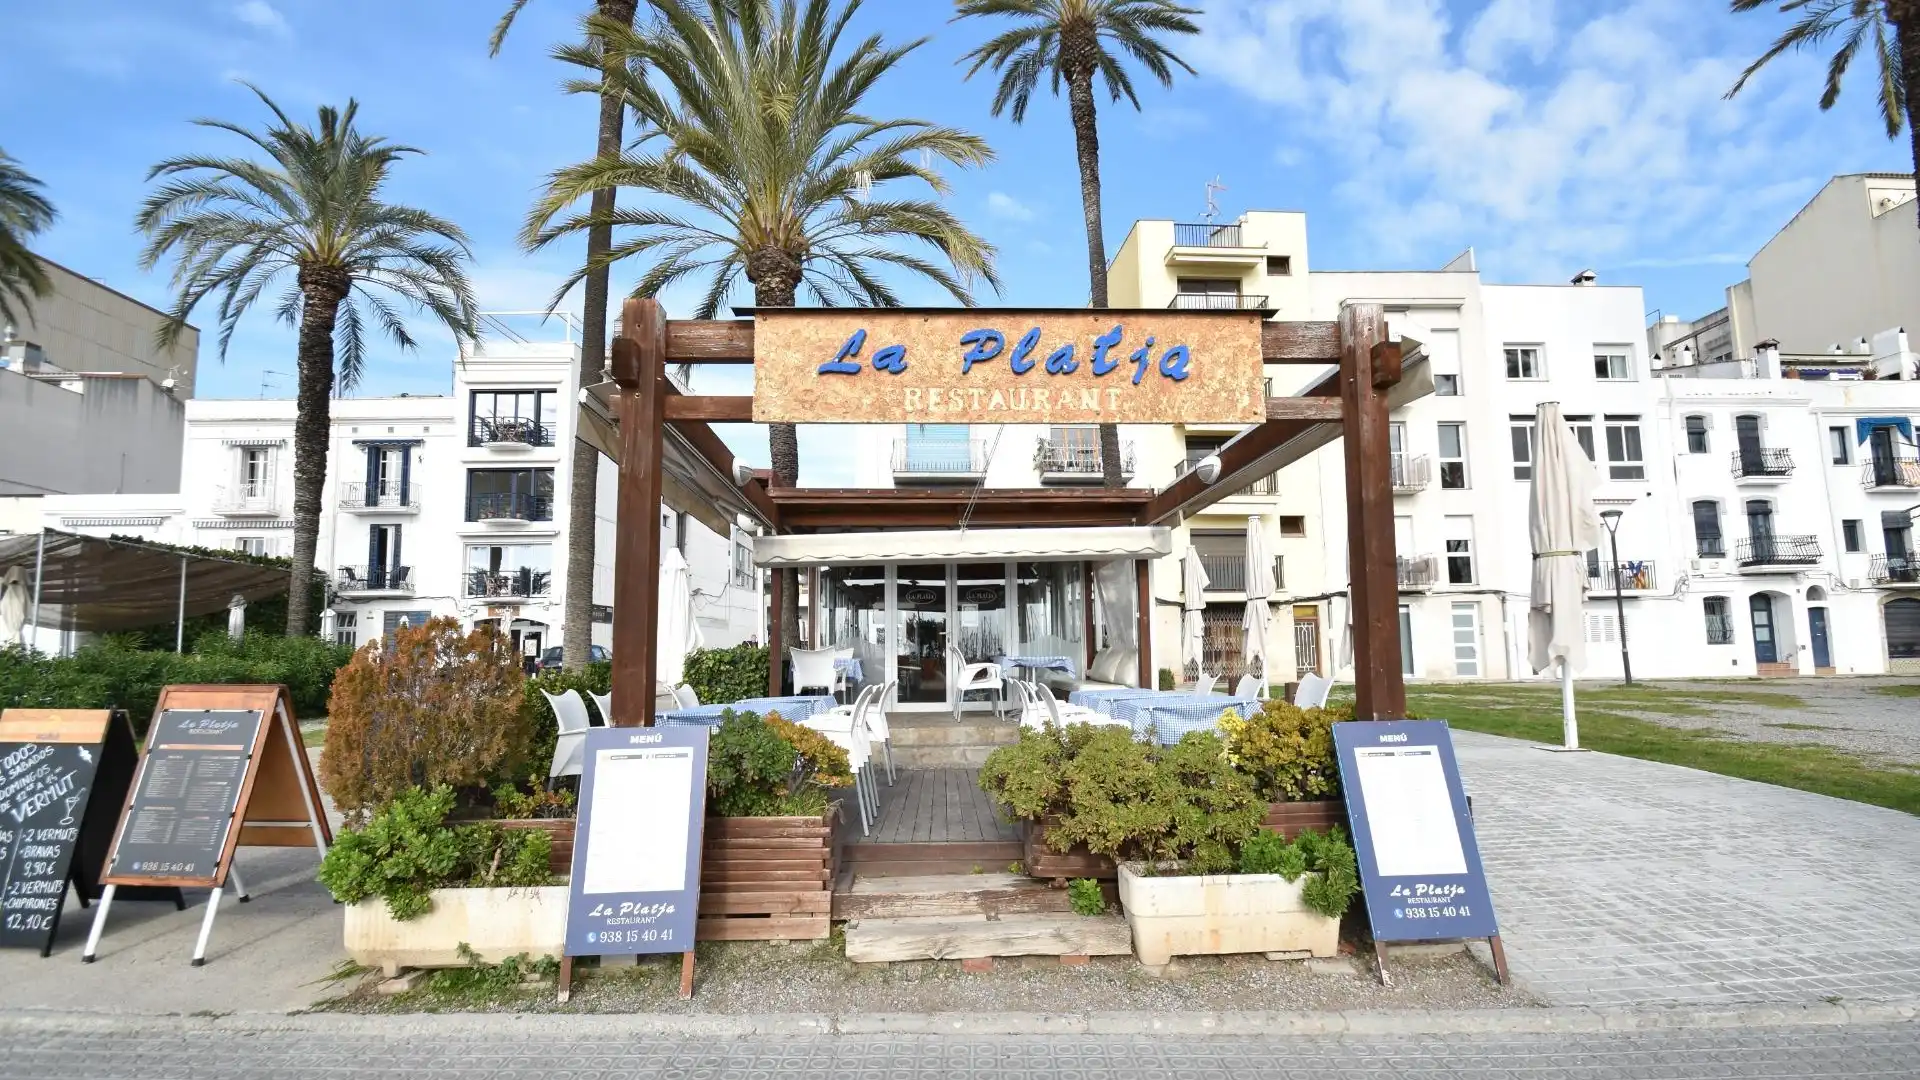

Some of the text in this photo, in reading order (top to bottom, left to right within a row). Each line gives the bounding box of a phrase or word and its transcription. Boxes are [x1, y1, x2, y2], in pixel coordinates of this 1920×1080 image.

[818, 324, 1191, 385] La Platja
[903, 385, 1123, 413] RESTAURANT
[629, 732, 662, 744] MENÚ
[1379, 732, 1408, 743] MENÚ
[10, 769, 78, 823] VERMUT
[37, 827, 78, 842] VERMUTS
[21, 880, 64, 894] VERMUTS
[1390, 883, 1466, 898] La Platja
[1407, 896, 1451, 904] RESTAURANT
[588, 901, 675, 917] La Platja
[1405, 905, 1471, 919] 938 15 40 41
[607, 916, 657, 925] RESTAURANT
[600, 928, 673, 943] 938 15 40 41
